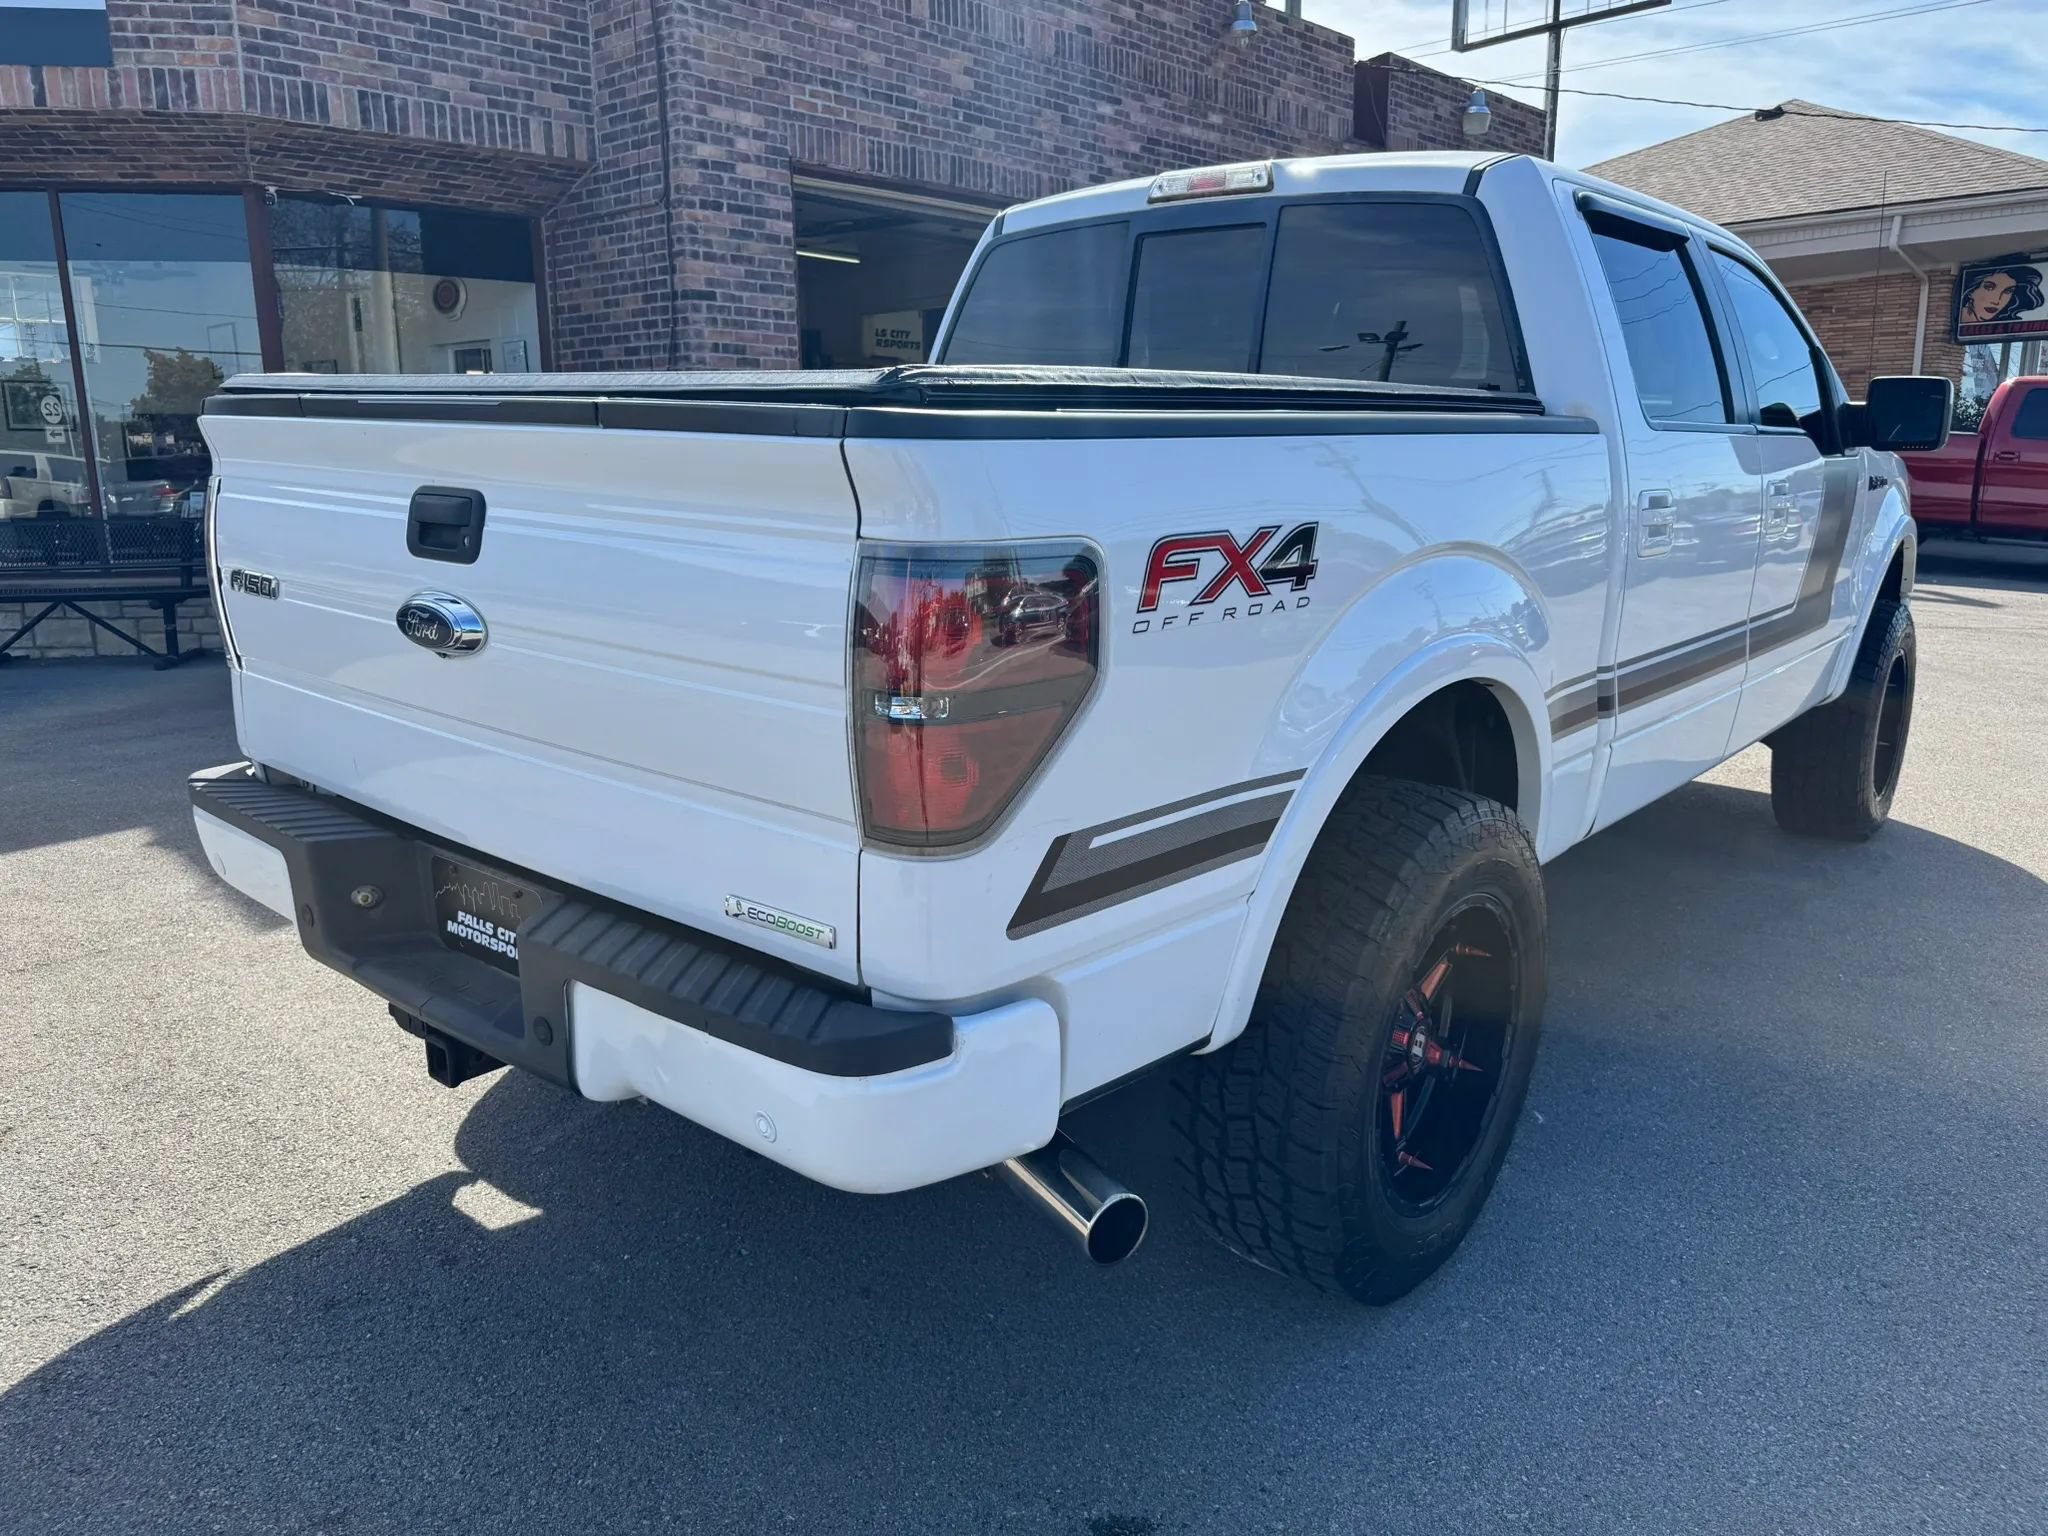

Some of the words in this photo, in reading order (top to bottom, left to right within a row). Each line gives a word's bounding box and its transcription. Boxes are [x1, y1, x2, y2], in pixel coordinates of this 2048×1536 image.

[890, 329, 911, 340] CITY
[1136, 521, 1320, 614] FX4
[406, 608, 439, 640] Ford
[1132, 611, 1205, 634] OFF
[1222, 596, 1311, 620] ROAD
[447, 920, 519, 960] MOTORSPO
[457, 910, 494, 936] FALLS
[497, 926, 517, 944] CIT
